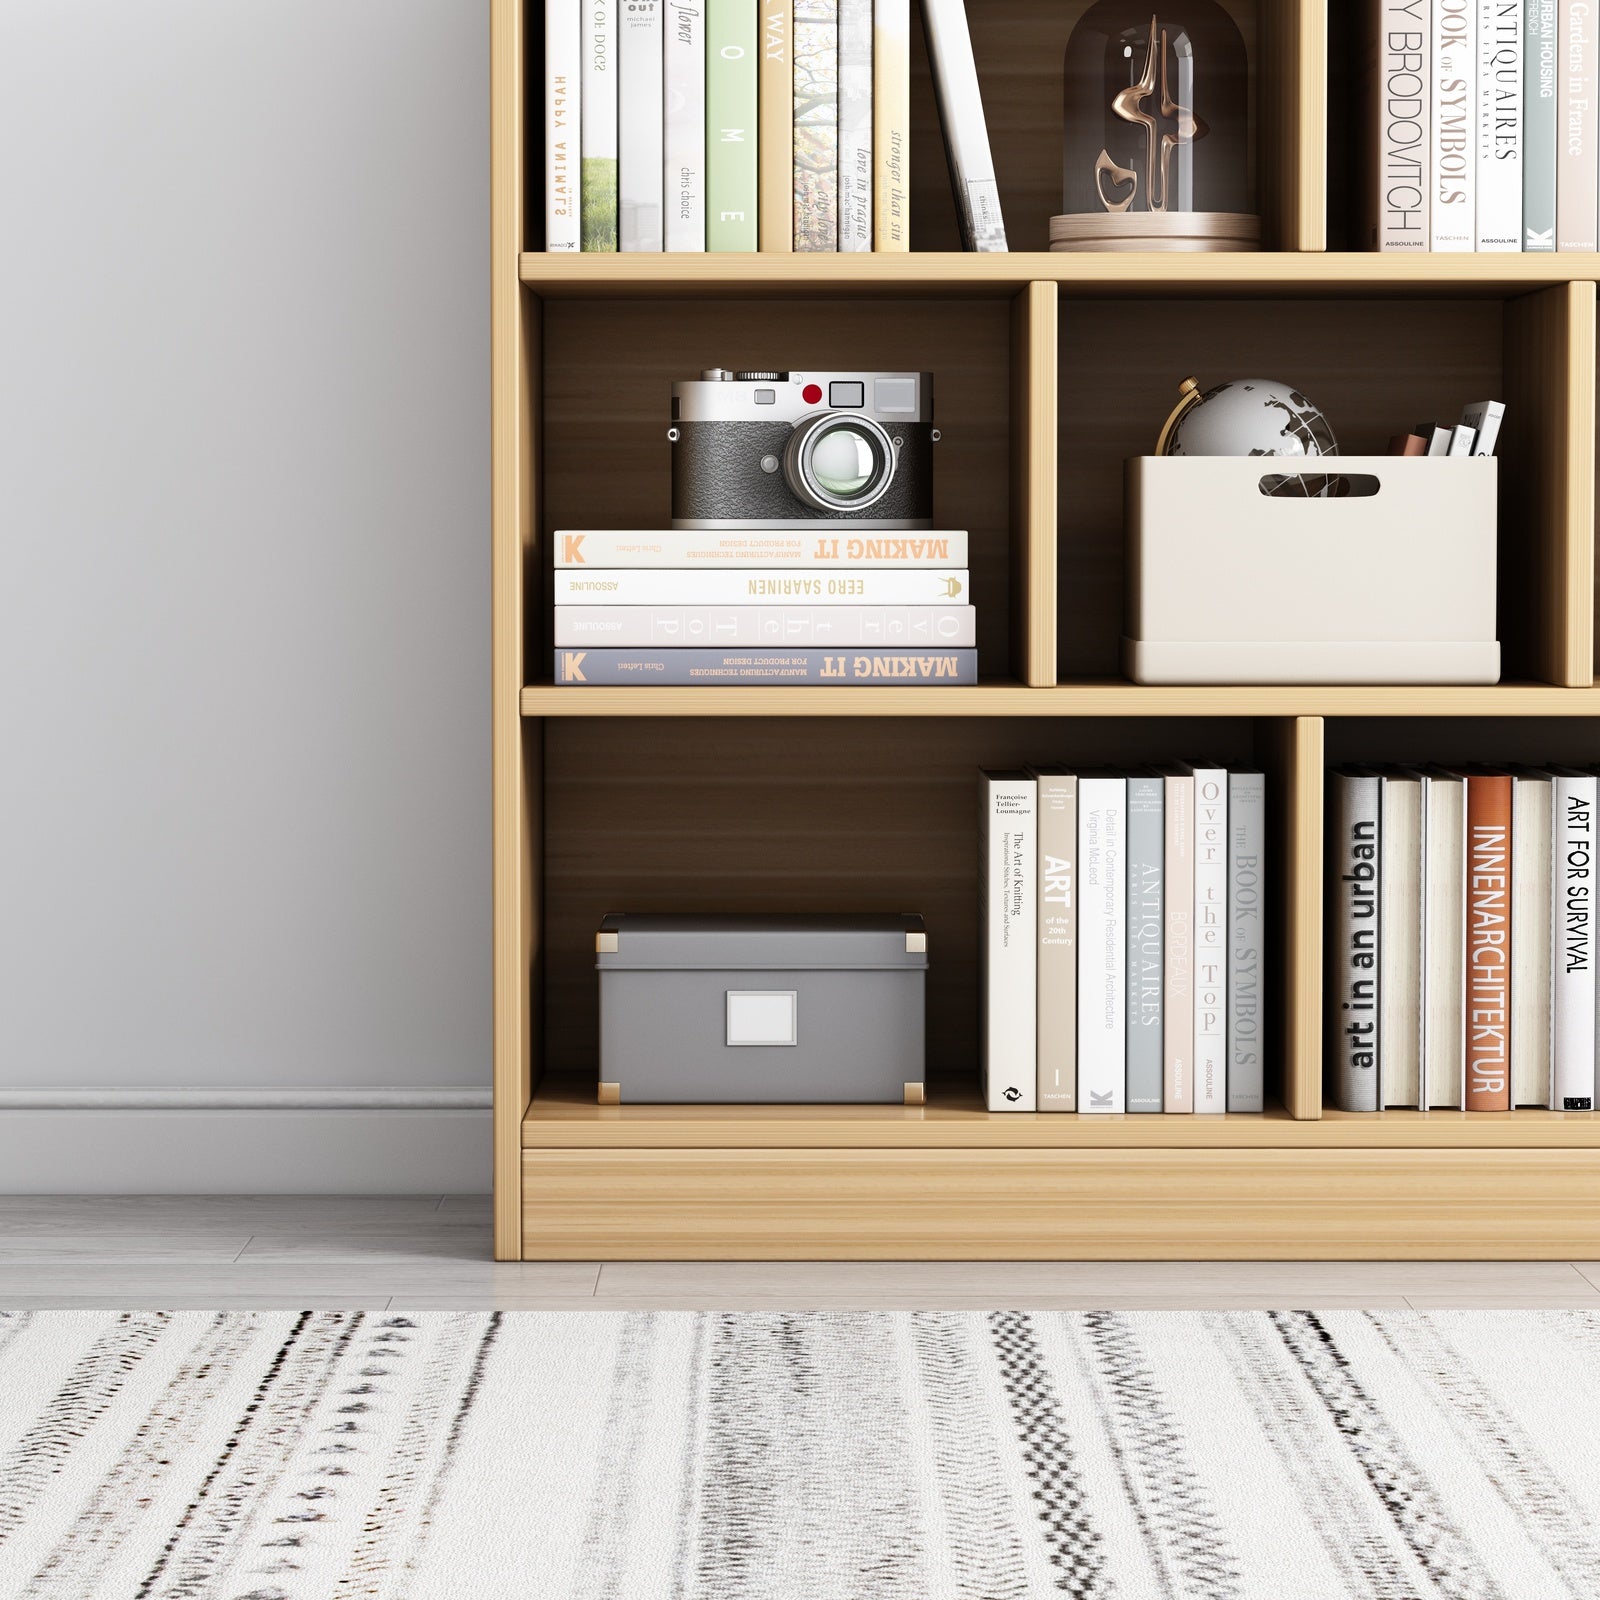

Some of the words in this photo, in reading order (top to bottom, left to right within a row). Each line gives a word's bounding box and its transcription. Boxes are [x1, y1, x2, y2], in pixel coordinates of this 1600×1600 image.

[628, 3, 654, 12] out
[670, 2, 699, 45] flower
[766, 11, 784, 63] WAY
[1568, 2, 1589, 72] Gardens
[1441, 56, 1453, 72] OF
[1482, 42, 1490, 77] FLEA
[1540, 41, 1553, 98] HOUSING
[1490, 2, 1518, 160] NTIQUAIRES
[1568, 77, 1589, 93] in
[1386, 32, 1423, 230] BRODOVITCH
[1482, 90, 1490, 159] MARKETS
[1568, 97, 1589, 156] France
[885, 130, 902, 183] stronger
[1439, 79, 1468, 204] SYMBOLS
[857, 148, 871, 173] love
[681, 167, 696, 188] chris
[842, 175, 853, 189] josh
[857, 178, 869, 190] in
[681, 190, 696, 219] choice
[851, 196, 868, 240] prague
[891, 188, 906, 217] than
[891, 222, 903, 241] sin
[686, 550, 734, 558] TECHNIQUES
[735, 550, 801, 558] MANUFACTURING
[813, 538, 839, 559] IT
[847, 538, 949, 559] MAKING
[569, 581, 619, 592] ASSOULINE
[747, 578, 822, 595] SAARINEN
[827, 578, 864, 595] EERO
[573, 621, 623, 632] ASSOULINE
[655, 616, 738, 638] Top
[763, 616, 832, 639] the
[864, 615, 960, 638] Over
[644, 662, 665, 671] Chris
[689, 668, 738, 676] TECHNIQUES
[723, 657, 752, 665] DESIGN
[739, 668, 808, 676] MANUFACTURING
[753, 657, 790, 665] PRODUCT
[791, 657, 808, 665] FOR
[819, 656, 846, 677] IT
[853, 656, 959, 677] MAKING
[1087, 809, 1100, 845] Virginia
[1105, 809, 1117, 836] Detail
[1202, 782, 1219, 860] Over
[1567, 796, 1590, 832] ART
[1013, 832, 1024, 849] The
[1105, 838, 1117, 847] in
[1235, 825, 1247, 848] THE
[1013, 851, 1024, 866] Art
[1013, 868, 1024, 878] of
[1088, 848, 1100, 886] McLeod
[1342, 820, 1375, 919] urban
[1567, 841, 1590, 879] FOR
[1044, 855, 1071, 907] ART
[1103, 849, 1117, 916] Contemporary
[1130, 863, 1138, 905] PARIS
[1235, 854, 1257, 921] BOOK
[1011, 880, 1024, 916] Knitting
[1204, 886, 1217, 943] the
[1566, 886, 1590, 974] SURVIVAL
[1042, 937, 1073, 946] Century
[1105, 919, 1117, 971] Residential
[1130, 917, 1138, 949] FLEA
[1138, 862, 1160, 1026] ANTIQUAIRES
[1235, 927, 1247, 942] OF
[1169, 911, 1188, 998] BORDEAUX
[1353, 929, 1375, 969] an
[1472, 825, 1506, 1094] INNENARCHITEKTUR
[1104, 973, 1117, 1029] Architecture
[1130, 961, 1138, 1025] MARKETS
[1202, 964, 1218, 1031] Top
[1234, 948, 1257, 1066] SYMBOLS
[1343, 979, 1374, 1010] in
[1347, 1022, 1374, 1068] art
[1174, 1057, 1183, 1100] ASSOULINE
[1205, 1058, 1214, 1099] ASSOULINE
